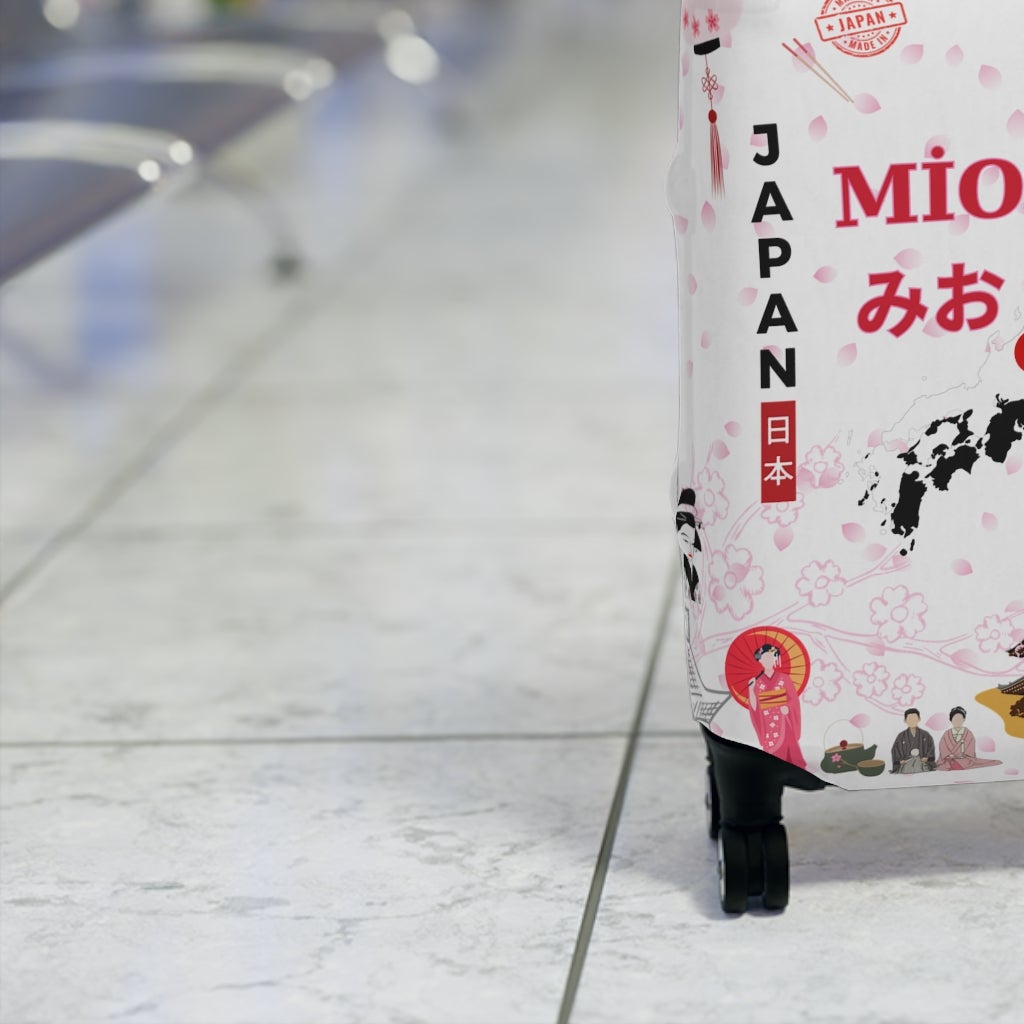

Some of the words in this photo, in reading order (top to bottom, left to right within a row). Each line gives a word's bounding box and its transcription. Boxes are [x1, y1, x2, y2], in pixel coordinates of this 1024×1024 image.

[838, 11, 886, 32] JAPAN
[848, 40, 876, 51] MADE
[877, 33, 889, 45] IN
[751, 123, 798, 389] JAPAN
[857, 262, 1006, 339] みお
[763, 416, 794, 486] 日本
